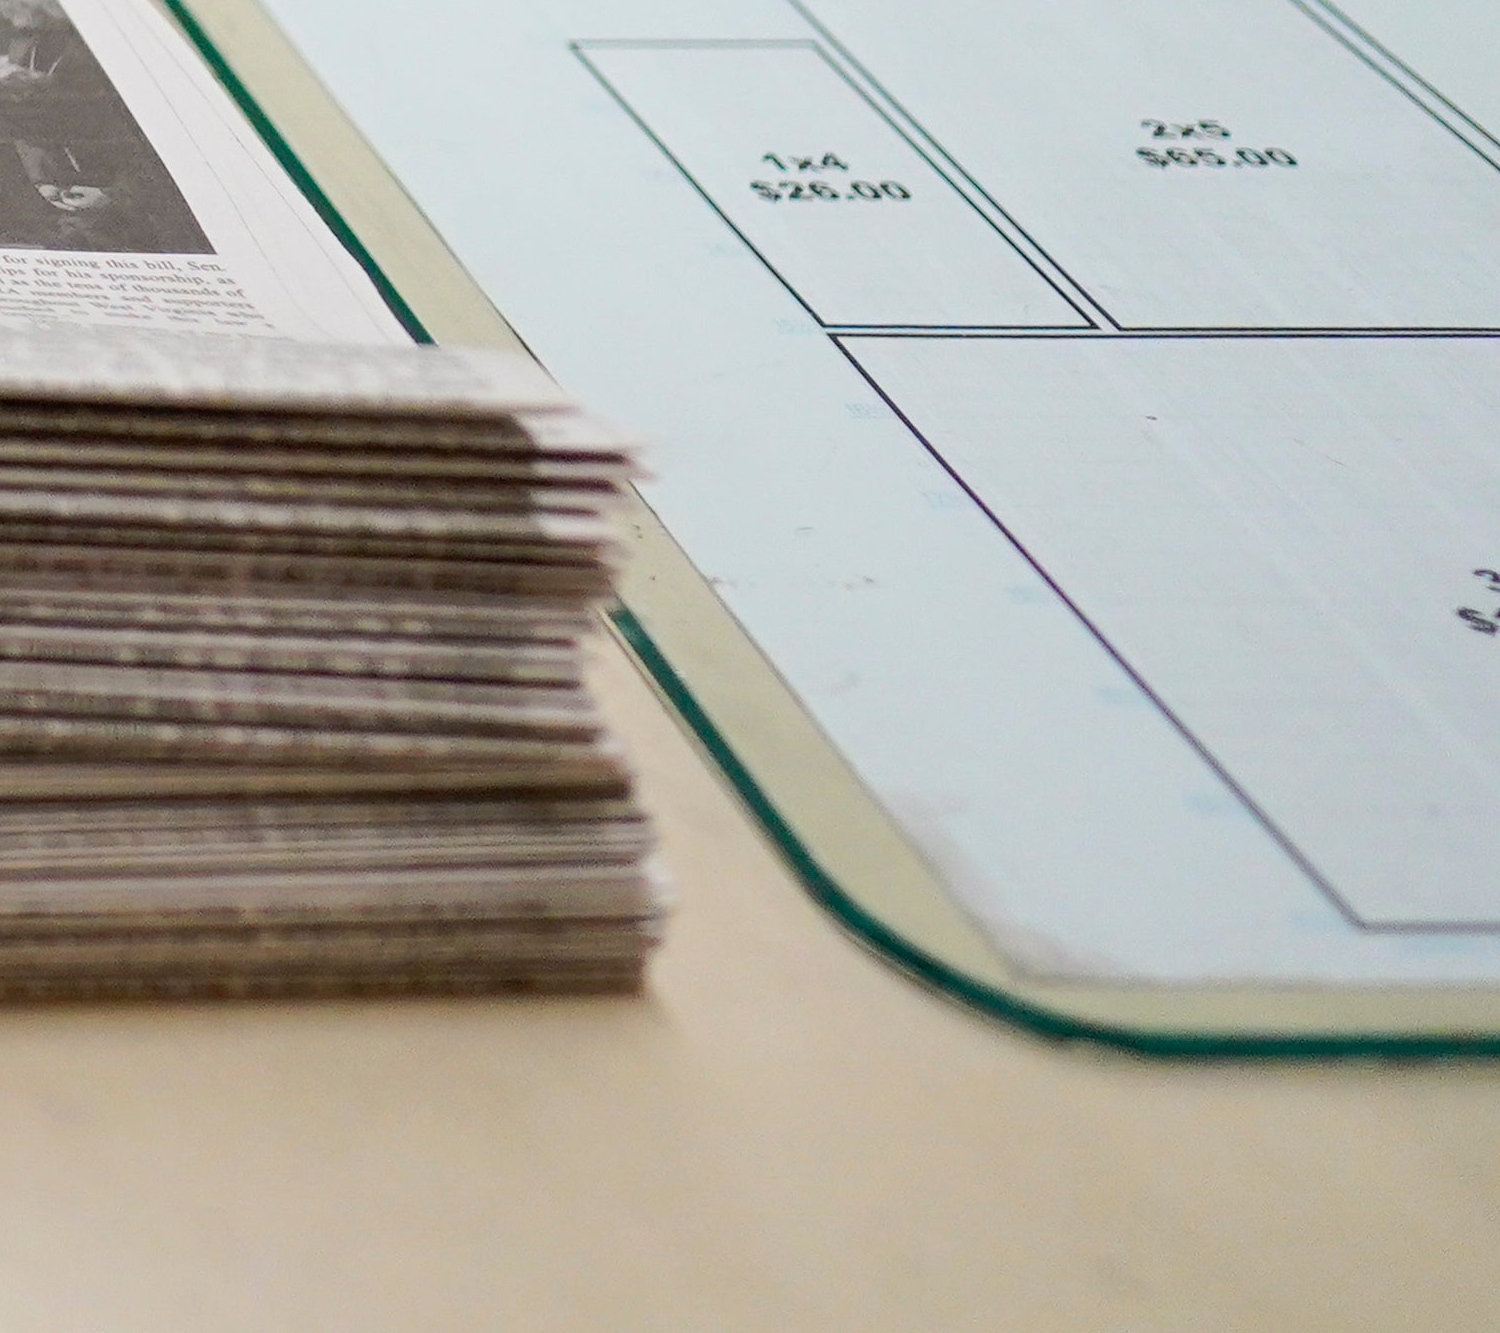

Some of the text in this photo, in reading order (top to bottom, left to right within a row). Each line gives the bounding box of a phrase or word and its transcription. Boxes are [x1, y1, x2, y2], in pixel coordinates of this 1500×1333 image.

[1141, 119, 1231, 140] 2x5
[762, 151, 850, 172] 1x4
[1135, 146, 1298, 168] $65.00
[750, 180, 912, 203] $26.00
